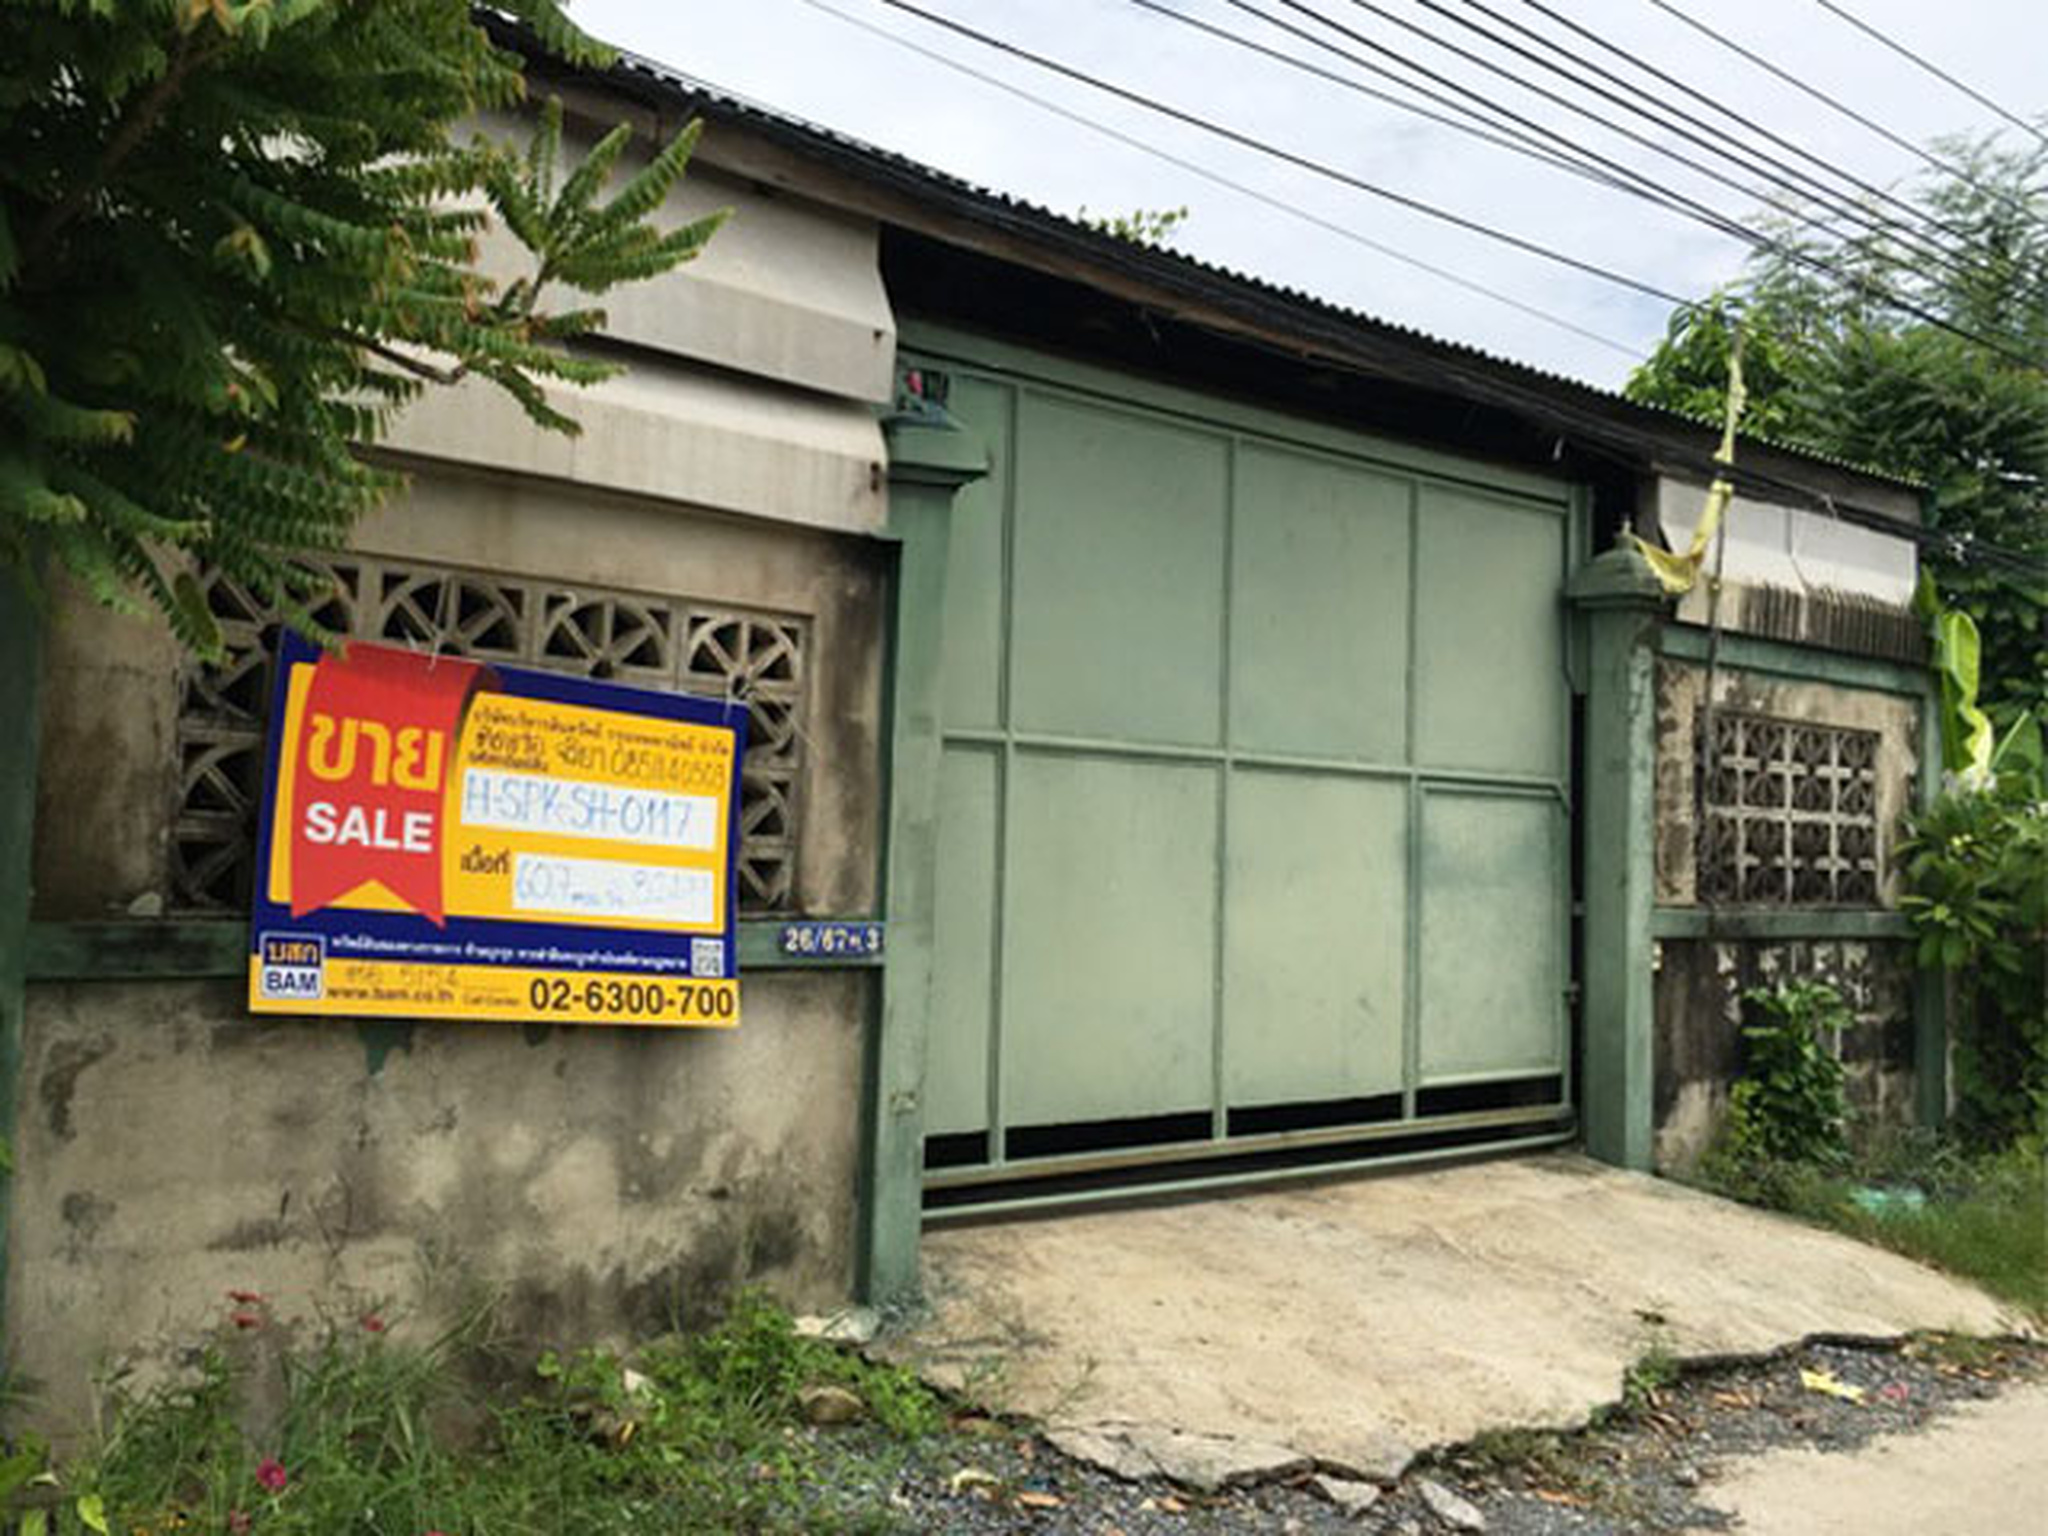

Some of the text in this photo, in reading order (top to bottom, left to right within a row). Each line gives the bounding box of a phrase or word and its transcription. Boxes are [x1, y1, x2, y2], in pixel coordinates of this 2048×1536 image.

[304, 715, 444, 791] ขาย
[304, 802, 434, 852] SALE
[265, 973, 320, 992] BAM
[530, 977, 734, 1019] 02-6300-700
